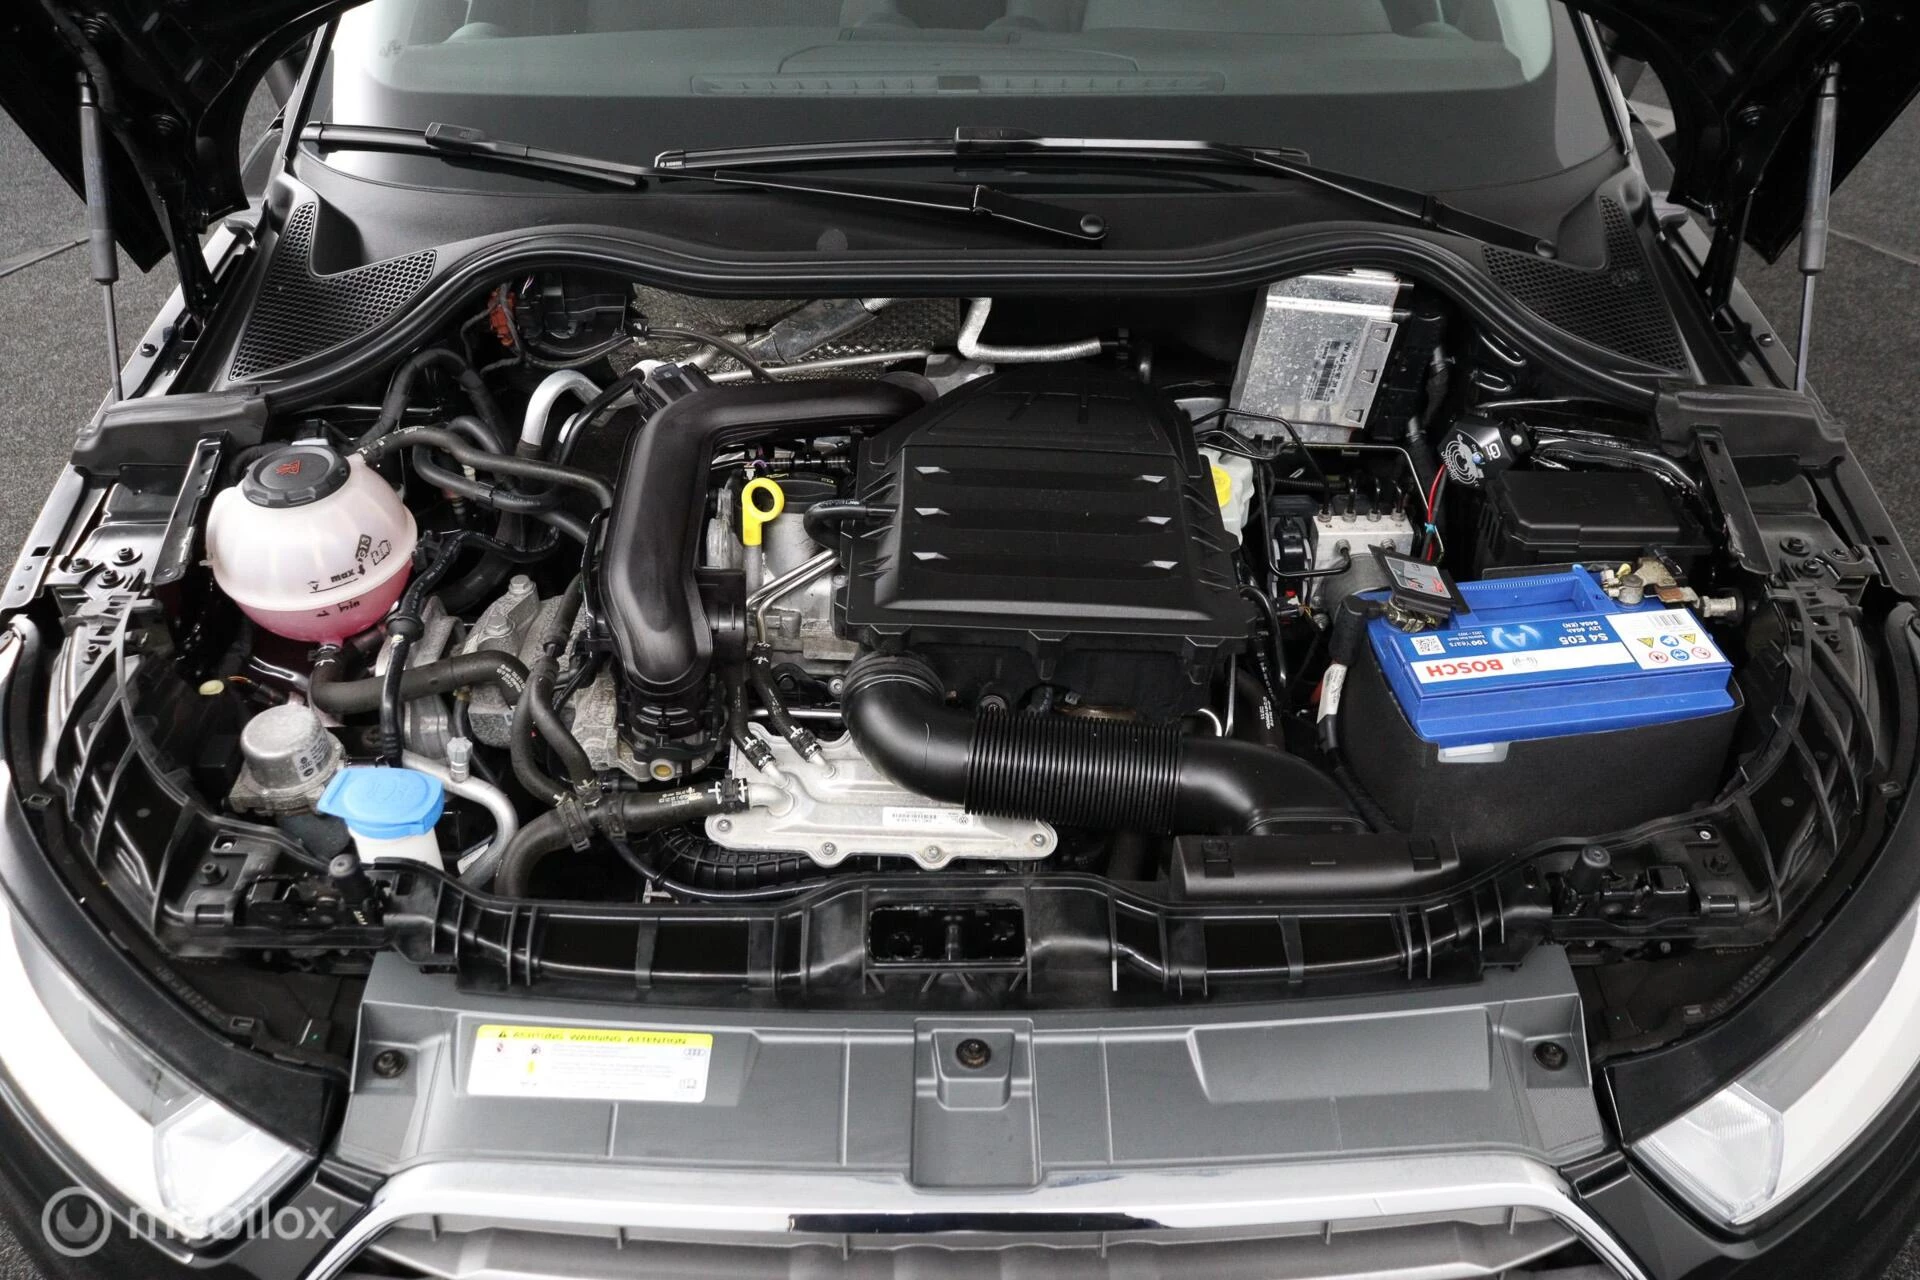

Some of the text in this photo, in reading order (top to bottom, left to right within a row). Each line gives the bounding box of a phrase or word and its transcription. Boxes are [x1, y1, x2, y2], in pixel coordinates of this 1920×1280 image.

[330, 569, 355, 583] max
[1558, 633, 1609, 645] S4 E05
[1426, 659, 1504, 677] BOSCH
[569, 1034, 622, 1043] WARNING
[627, 1036, 687, 1045] ATTENTION
